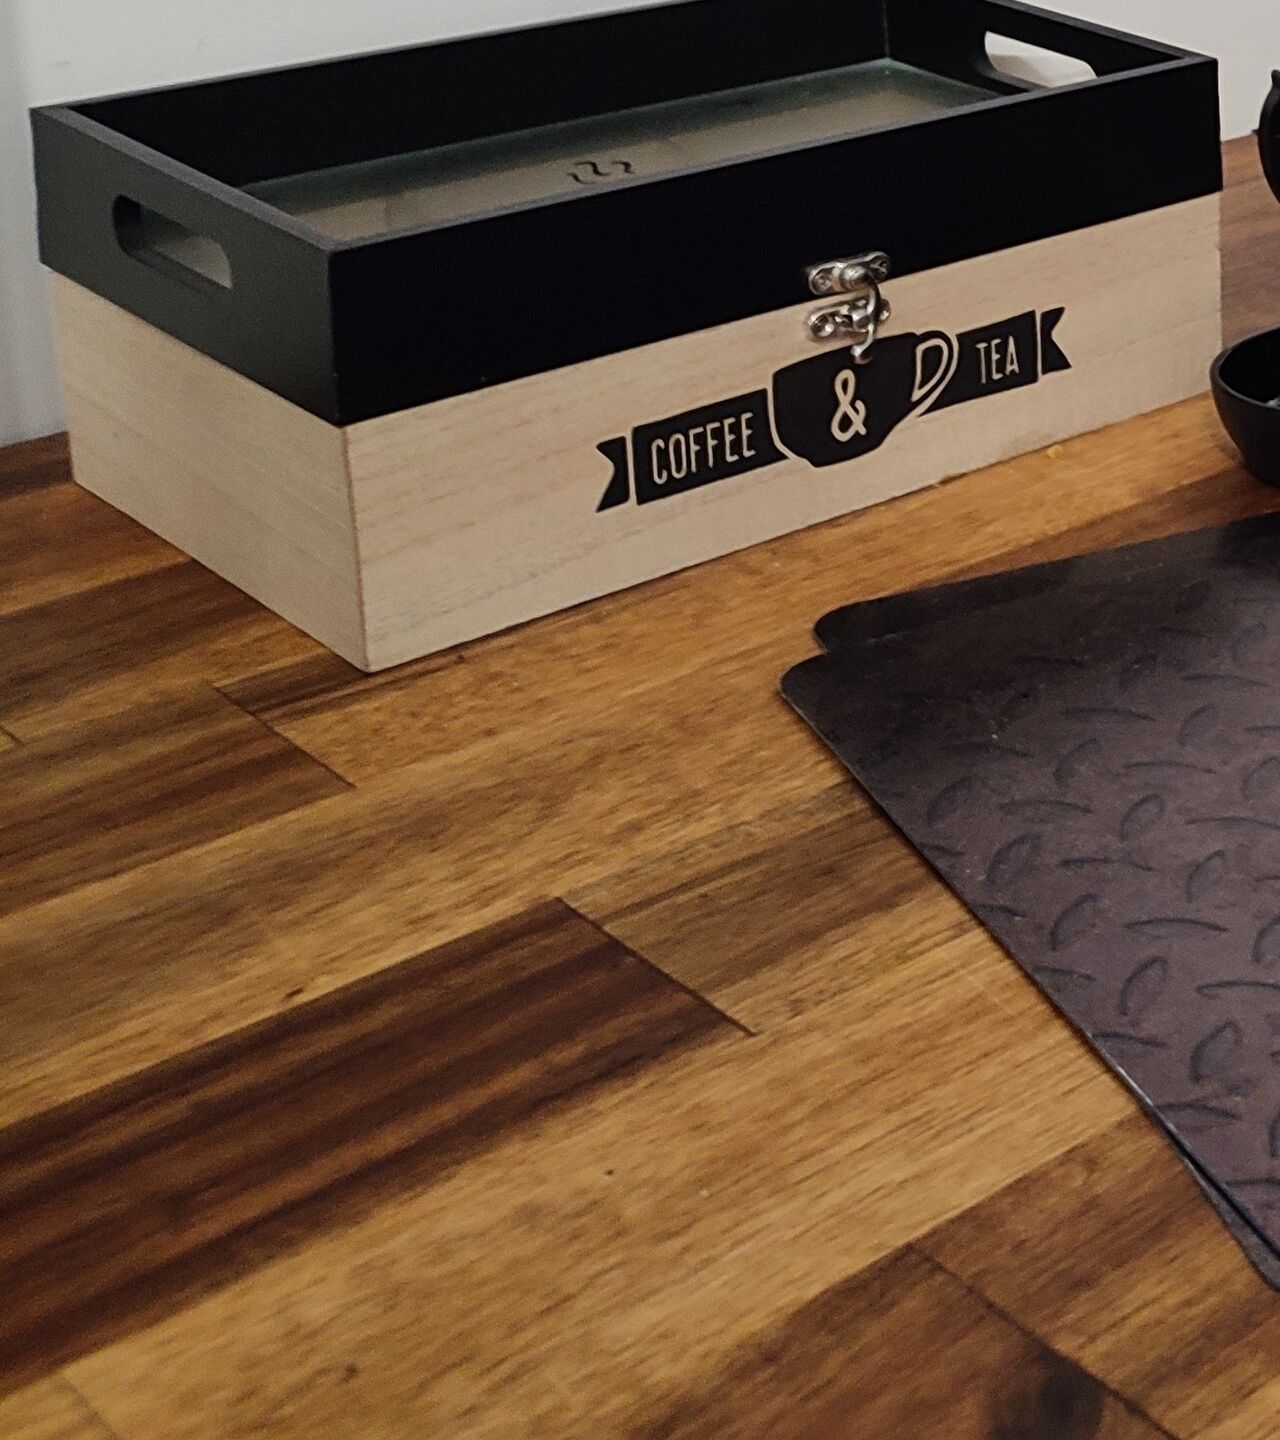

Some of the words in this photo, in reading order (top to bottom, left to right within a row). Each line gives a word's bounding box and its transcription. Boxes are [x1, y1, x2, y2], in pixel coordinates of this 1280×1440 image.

[651, 411, 757, 486] COFFEE
[829, 367, 869, 442] &
[974, 334, 1021, 385] TEA
